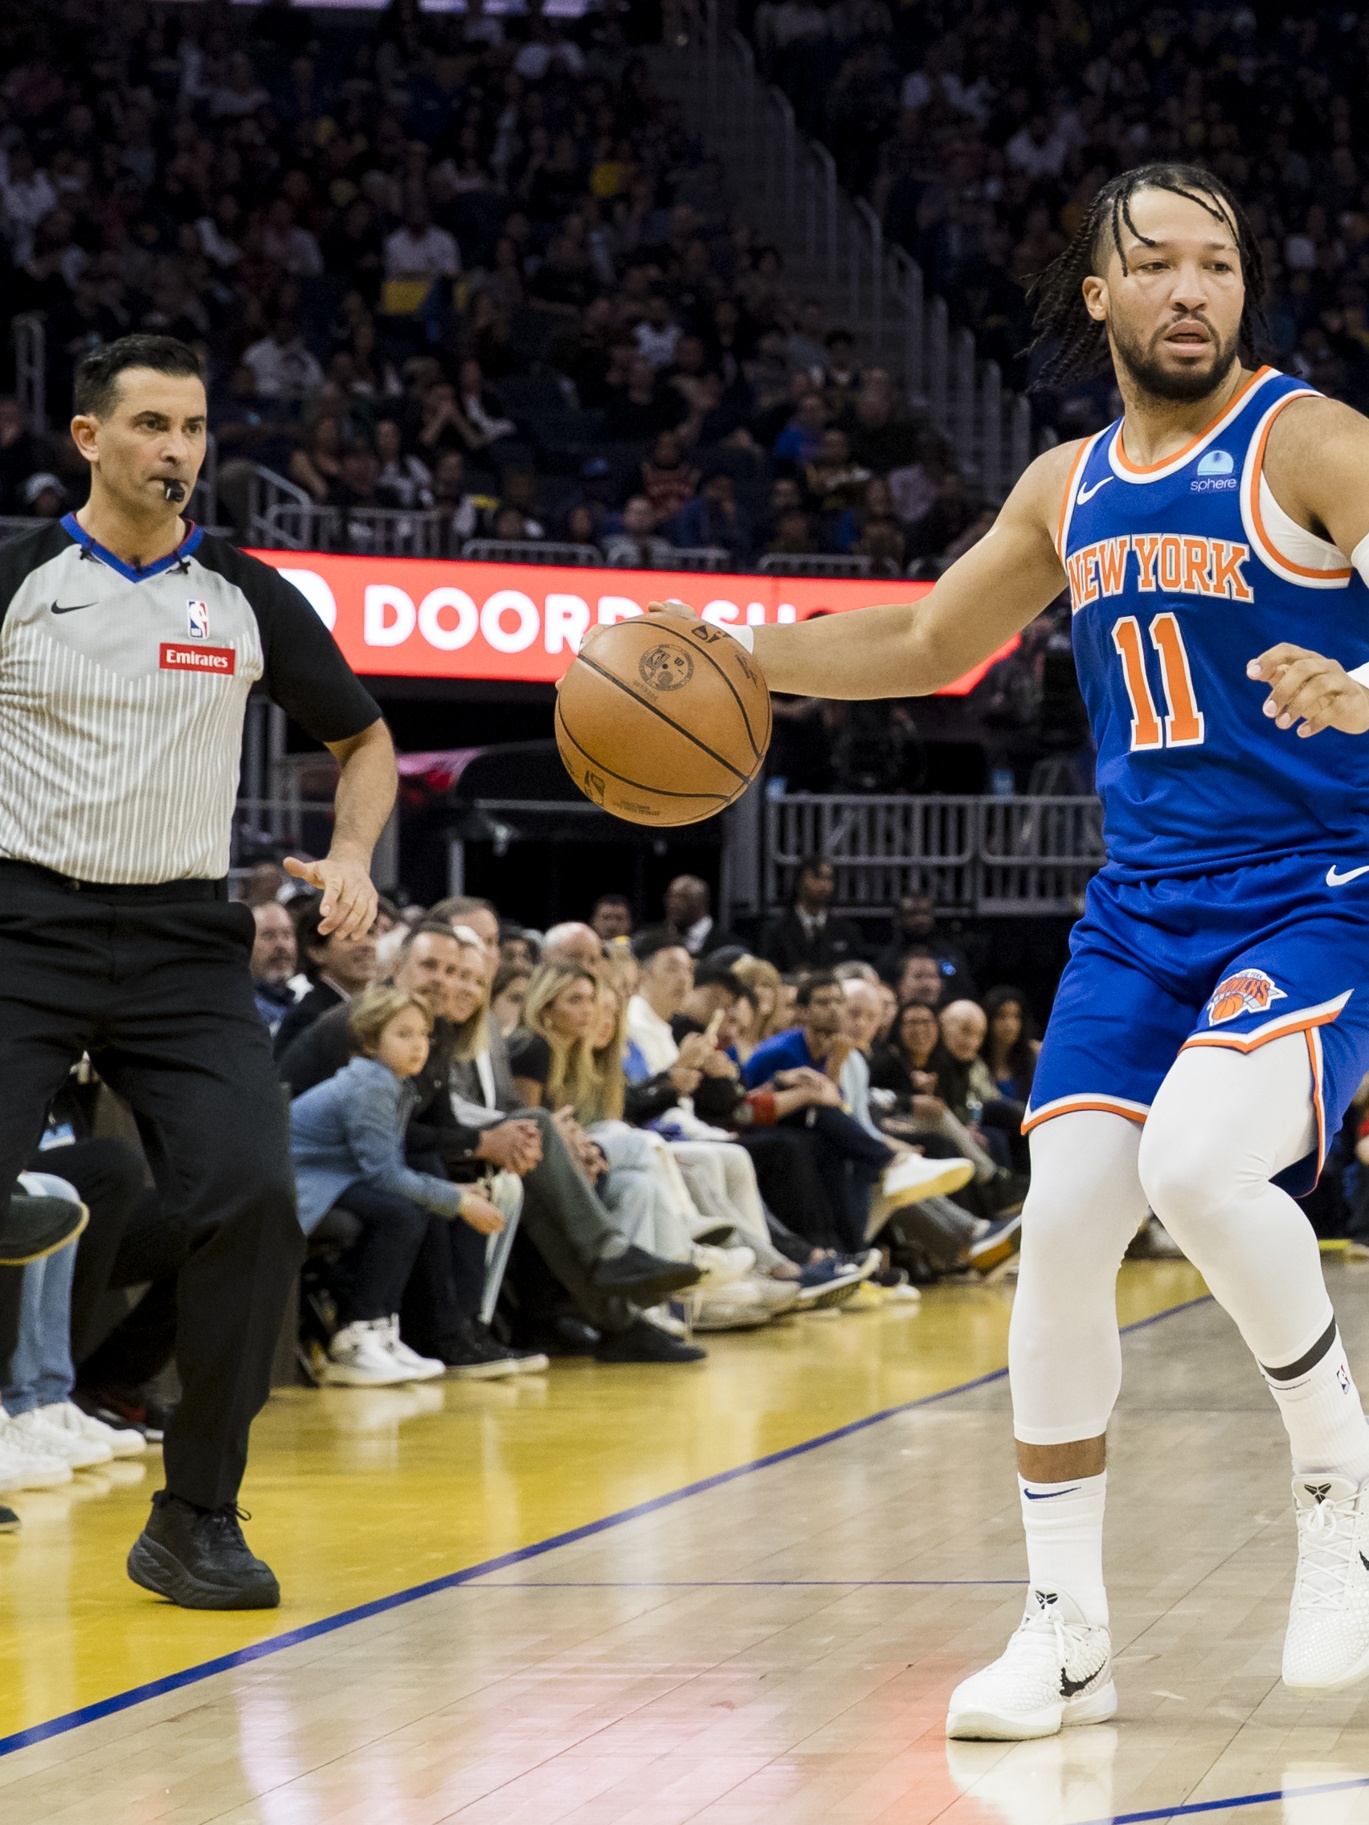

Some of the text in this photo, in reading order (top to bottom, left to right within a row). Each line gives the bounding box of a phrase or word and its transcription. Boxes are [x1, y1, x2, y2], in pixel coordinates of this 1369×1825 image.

[1190, 478, 1237, 493] sphere
[1066, 532, 1254, 616] NEW YORK
[364, 584, 797, 656] DOOR
[166, 649, 228, 669] Emirates
[1111, 612, 1205, 751] 11
